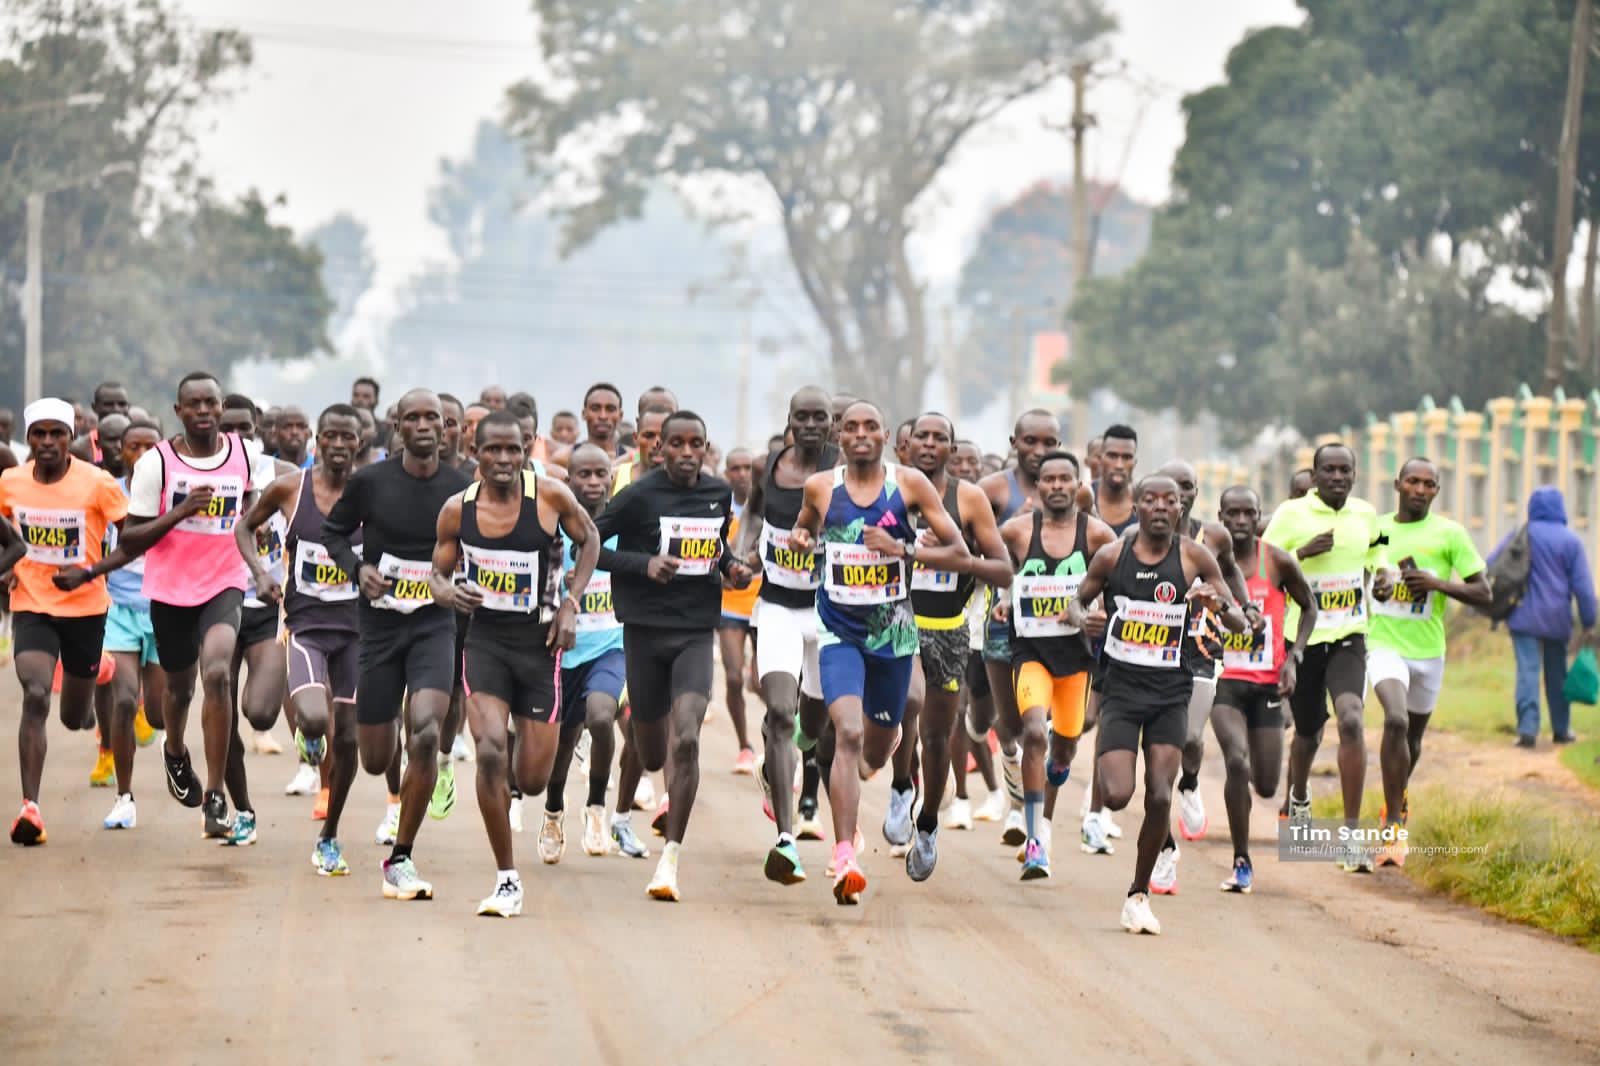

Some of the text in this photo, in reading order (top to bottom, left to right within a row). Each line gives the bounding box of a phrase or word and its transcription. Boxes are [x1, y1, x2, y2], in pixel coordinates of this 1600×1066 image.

[28, 526, 67, 548] 0245
[681, 537, 717, 559] 0045
[509, 559, 529, 568] RUN
[775, 547, 815, 573] 0304
[477, 566, 516, 594] 0276
[843, 564, 888, 588] 0043
[1320, 587, 1356, 610] 0270
[1121, 620, 1169, 647] 0040
[1222, 630, 1253, 653] 282
